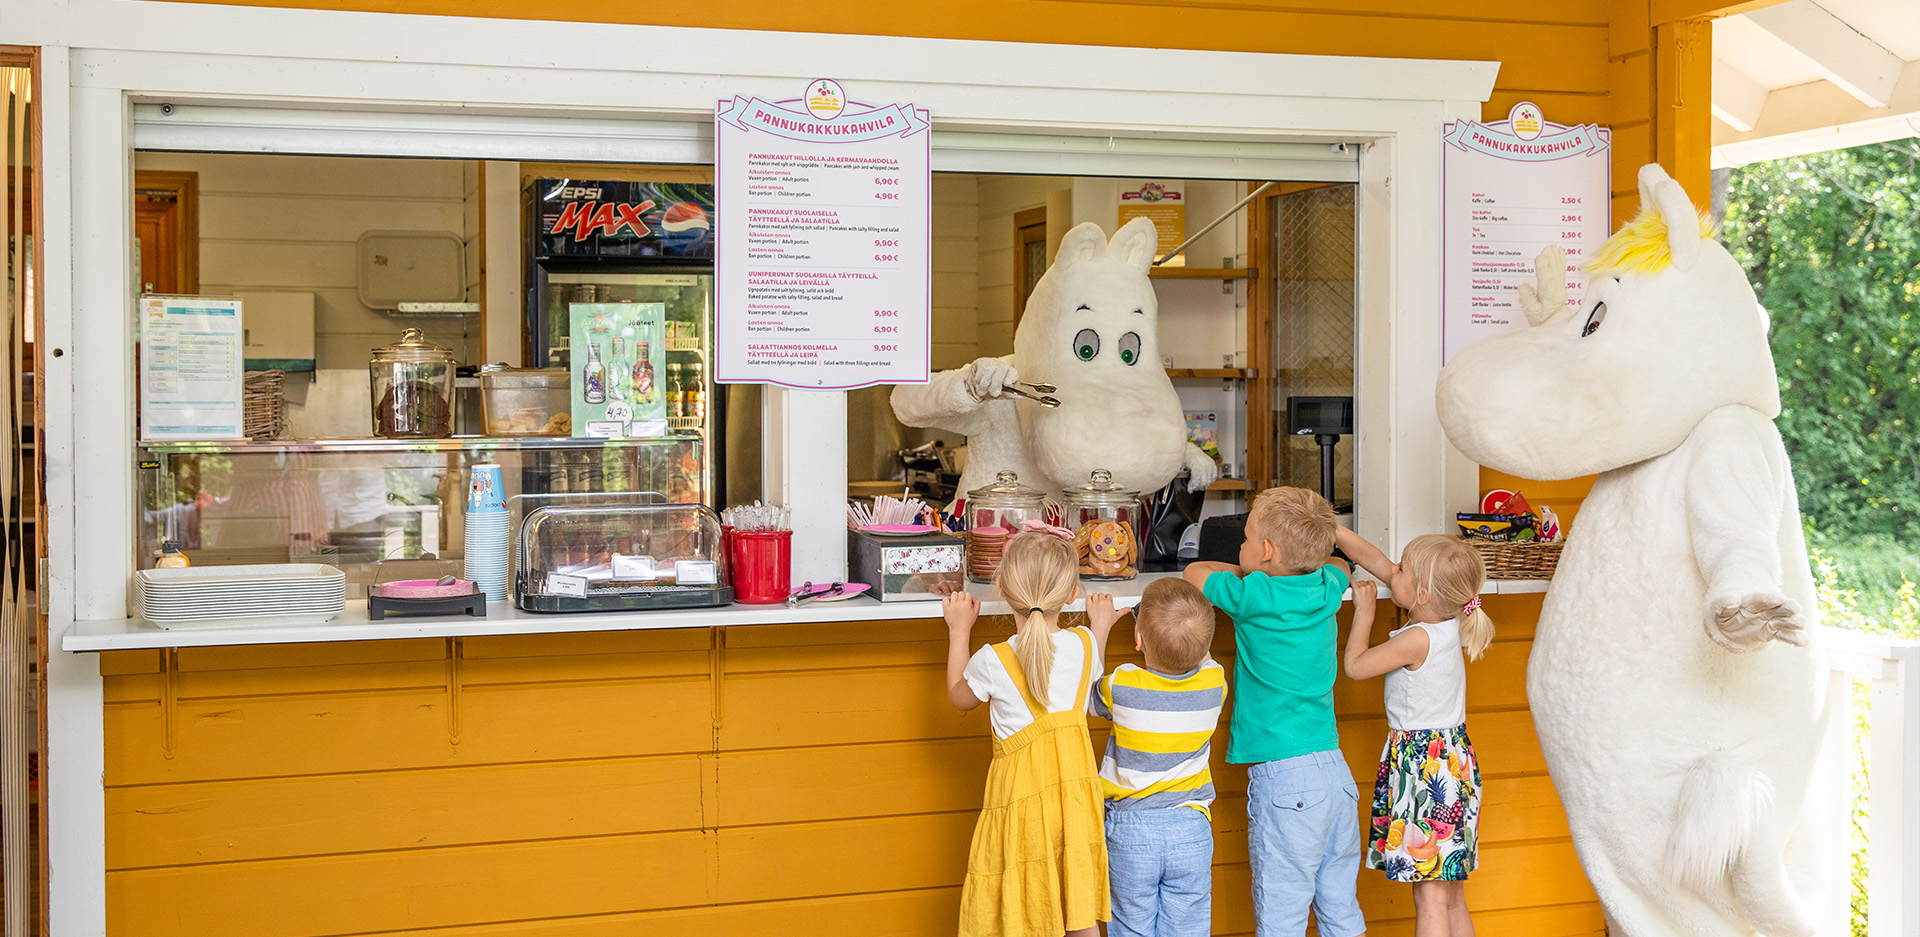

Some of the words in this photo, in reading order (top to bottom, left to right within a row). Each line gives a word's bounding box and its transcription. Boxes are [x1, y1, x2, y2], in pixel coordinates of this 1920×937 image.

[755, 109, 895, 135] PANNUKAKKUKAHVILA
[1472, 132, 1582, 154] PANNUKAKKUKAHVILA
[550, 199, 656, 242] MAX
[607, 408, 627, 419] 4,70
